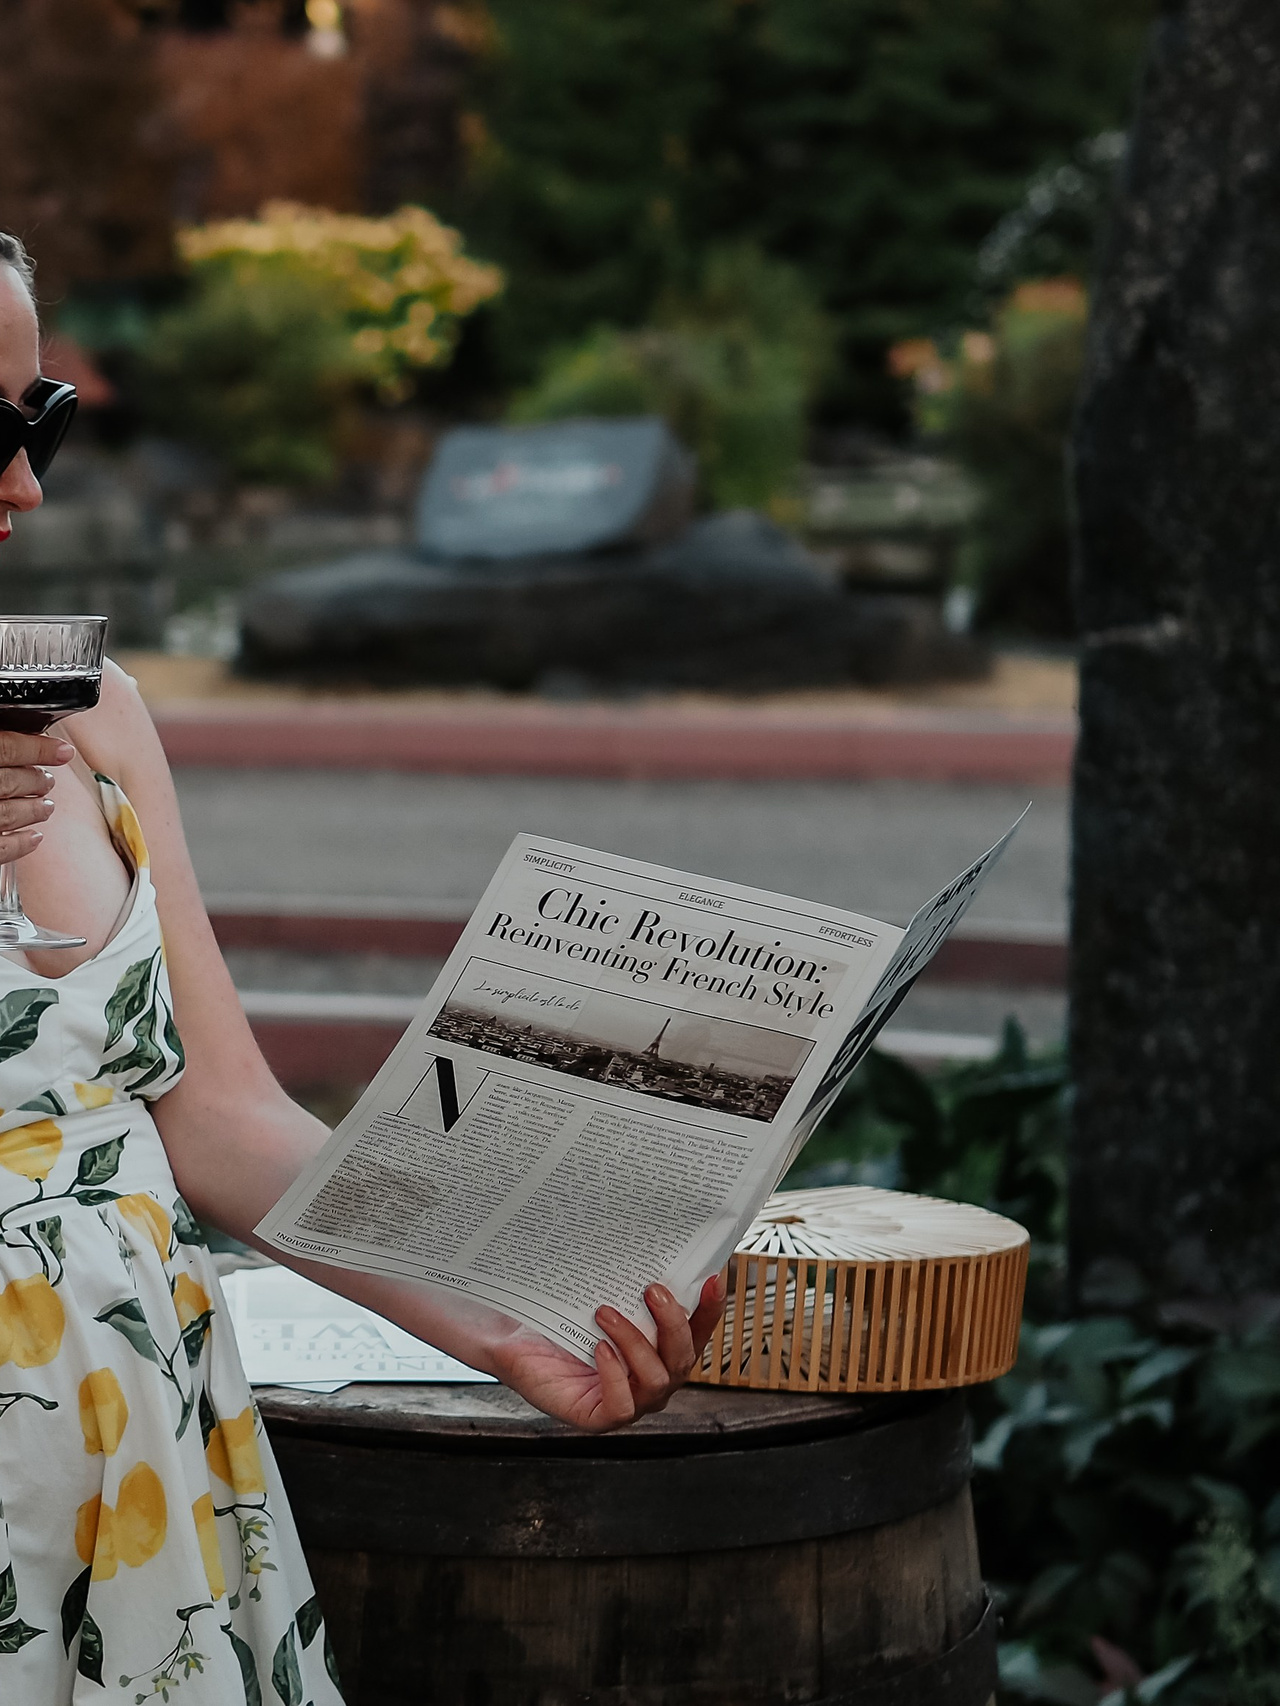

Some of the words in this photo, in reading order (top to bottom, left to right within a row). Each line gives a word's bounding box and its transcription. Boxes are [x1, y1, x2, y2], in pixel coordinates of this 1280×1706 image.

[523, 853, 576, 874] SIMPLICITY
[678, 891, 726, 910] ELEGANCE
[536, 886, 620, 936] Chic
[625, 908, 829, 985] Revolution:
[818, 925, 874, 949] EFFORTLESS
[485, 911, 658, 984] Reinventing
[661, 957, 757, 1001] French
[763, 981, 836, 1020] Style
[276, 1231, 342, 1255] INDIVIDUALITY
[424, 1269, 471, 1288] ROMANTIC
[559, 1322, 597, 1350] CONFIDE
